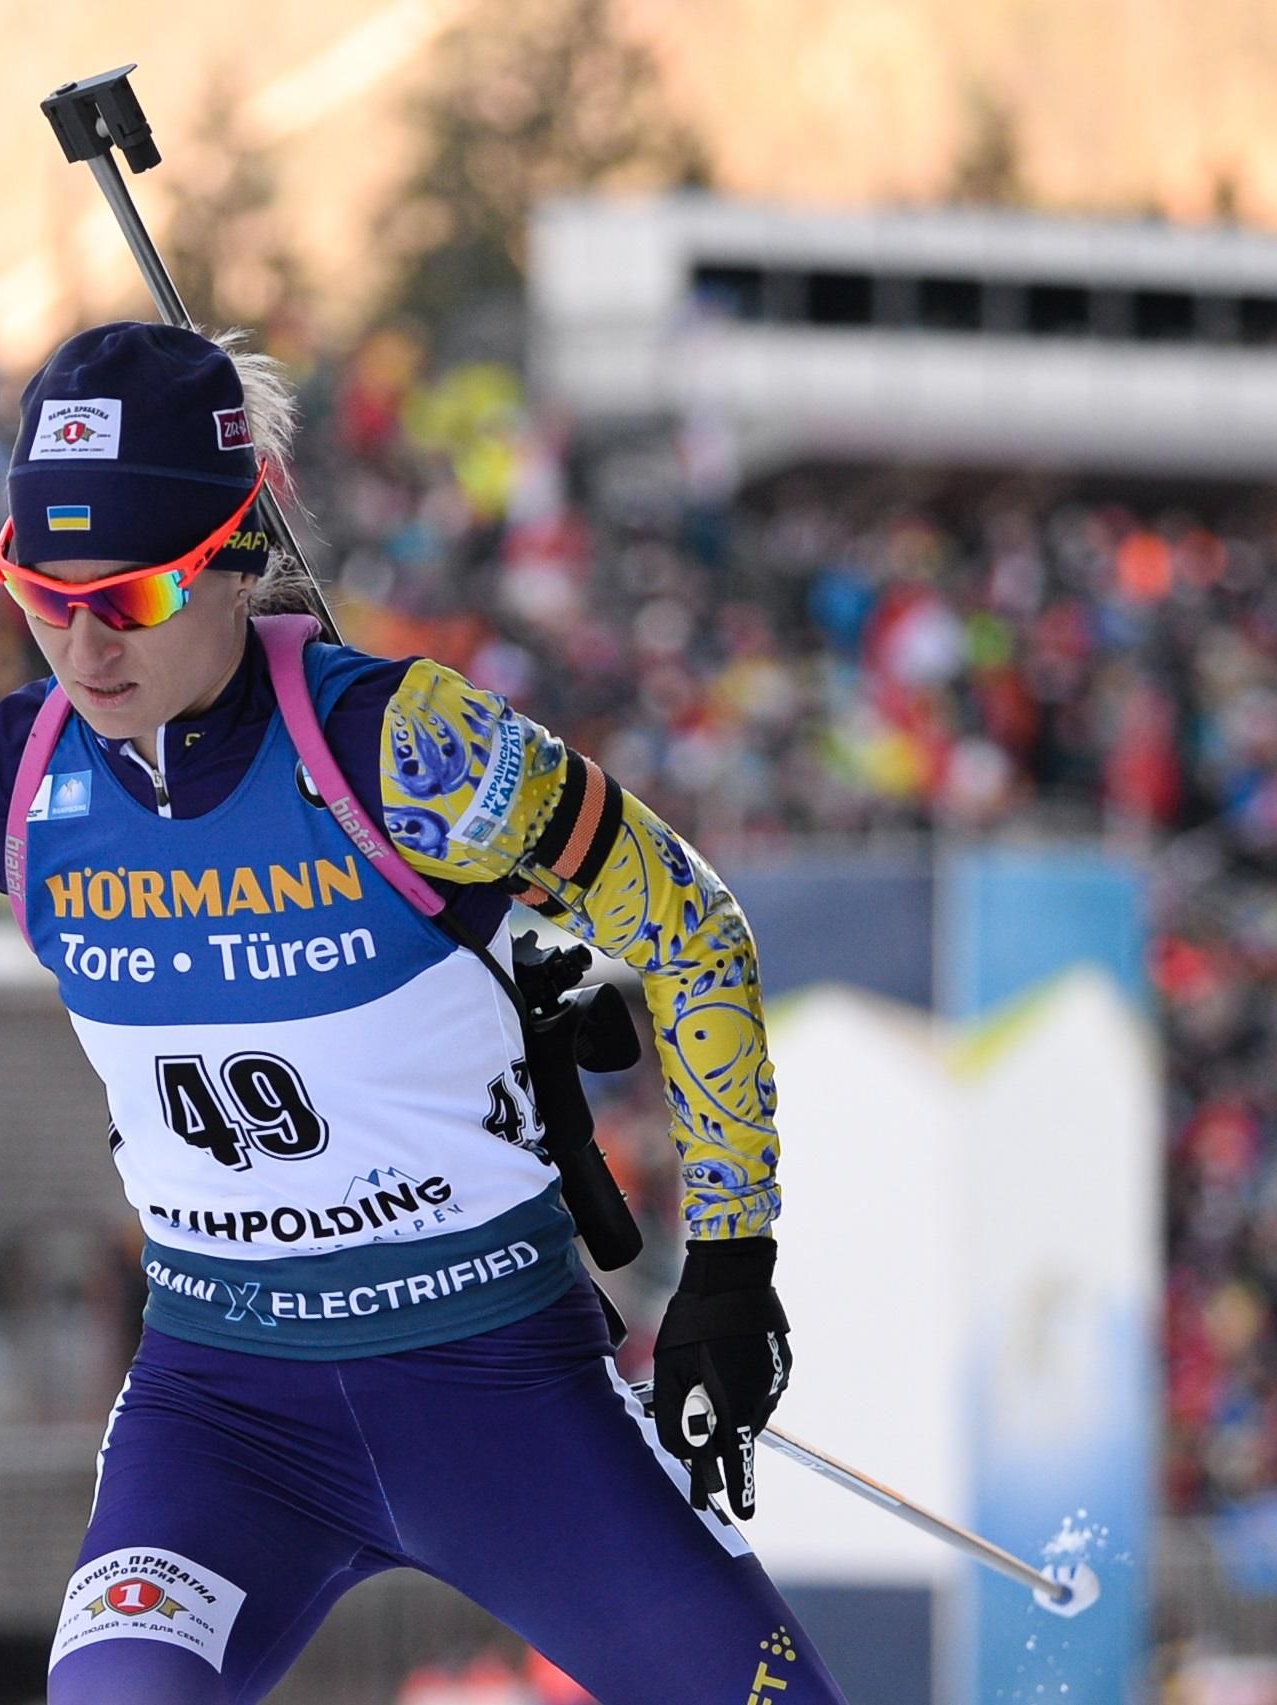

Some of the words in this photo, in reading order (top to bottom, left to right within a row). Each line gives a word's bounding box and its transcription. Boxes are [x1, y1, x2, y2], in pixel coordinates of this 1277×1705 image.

[223, 531, 269, 552] RAF
[44, 855, 363, 920] HÖRMANN
[60, 933, 155, 983] Tore
[208, 927, 377, 981] Türen
[154, 1050, 330, 1171] 49
[271, 1241, 540, 1320] ELECTRIFIED
[68, 1560, 121, 1600] ПЕРША
[129, 1555, 218, 1605] ПРИВАТНА
[117, 1583, 146, 1608] 1
